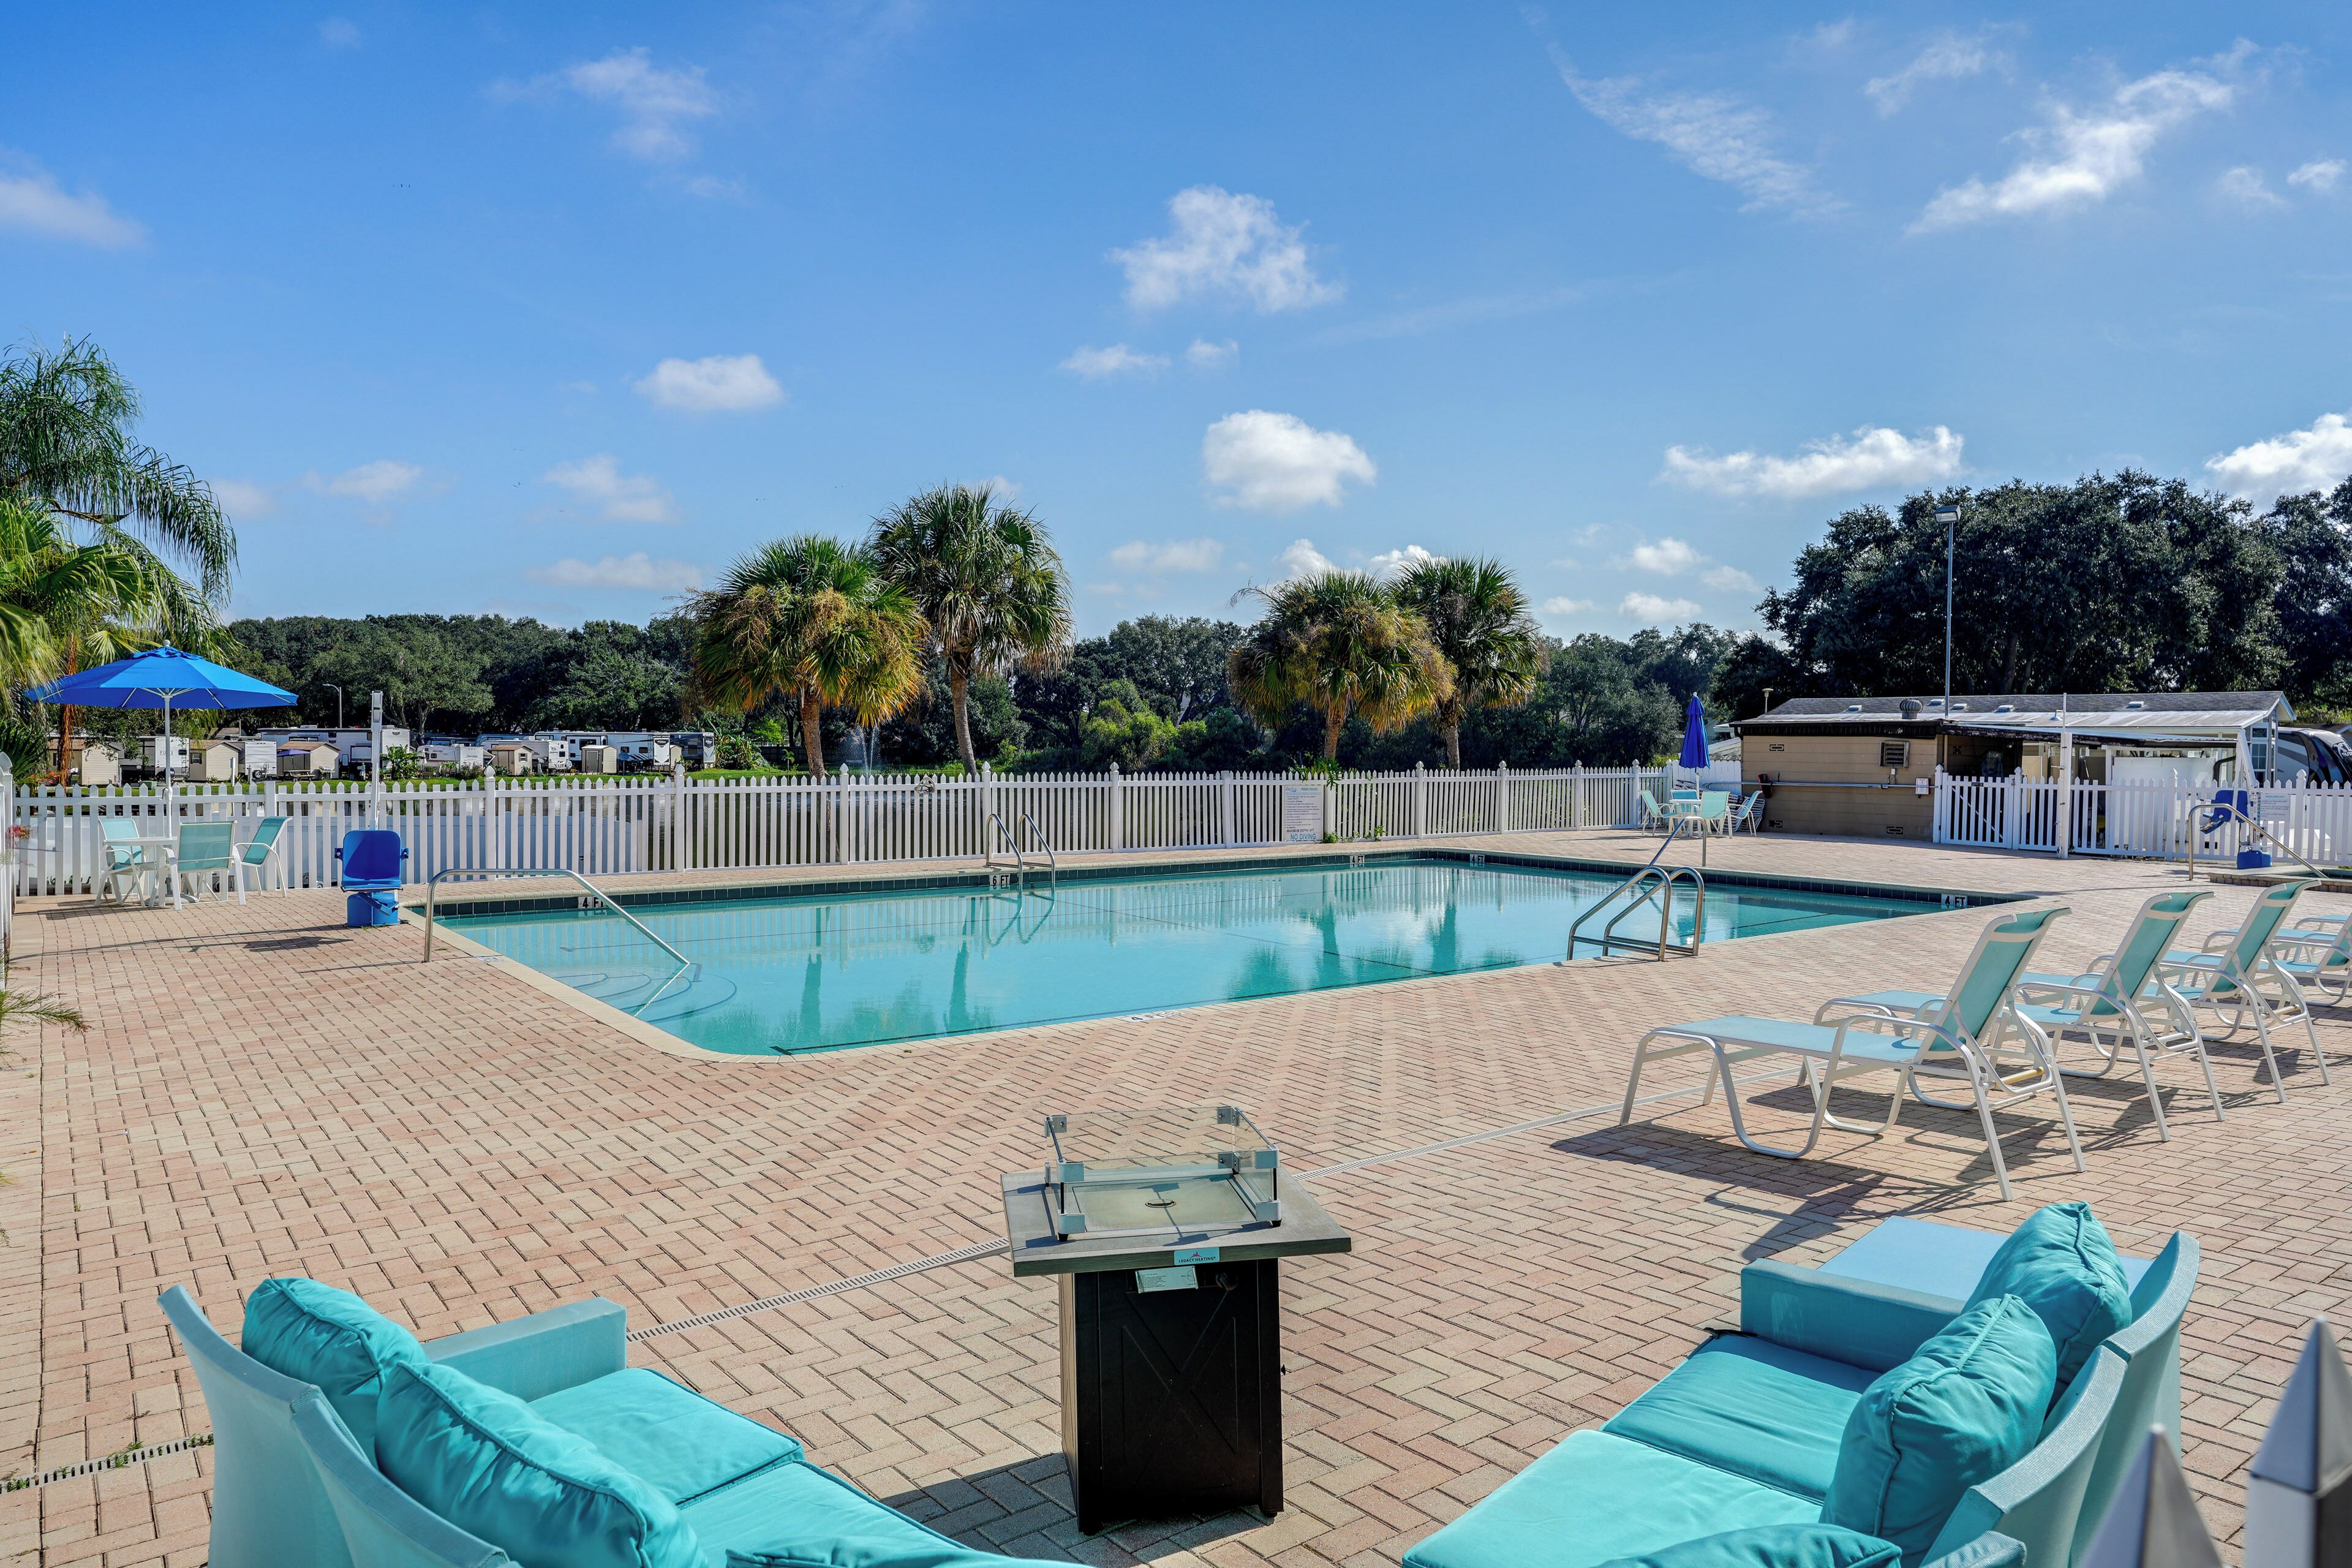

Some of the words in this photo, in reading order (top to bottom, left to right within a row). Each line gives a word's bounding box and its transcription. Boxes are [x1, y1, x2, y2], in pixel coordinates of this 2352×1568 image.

[992, 875, 997, 885] 6
[1000, 875, 1009, 884] FT
[582, 897, 589, 908] 4
[1945, 895, 1950, 905] 4
[1954, 896, 1966, 906] FT
